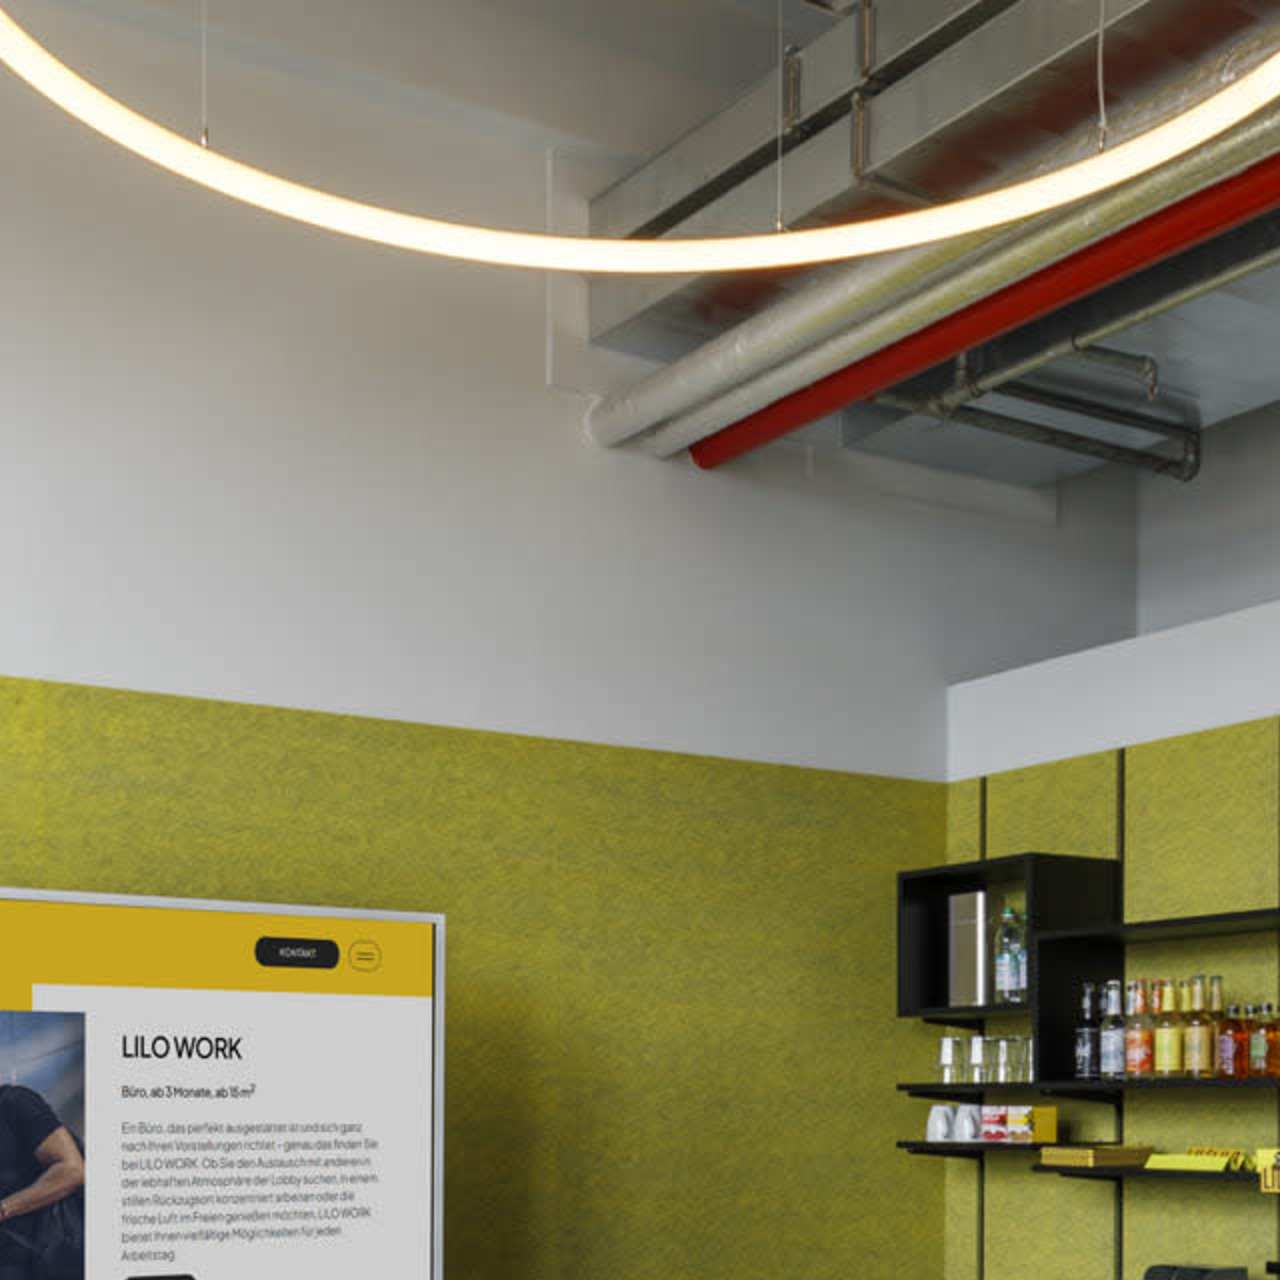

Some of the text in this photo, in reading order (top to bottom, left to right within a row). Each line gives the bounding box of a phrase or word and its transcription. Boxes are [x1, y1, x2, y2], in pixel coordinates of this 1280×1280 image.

[121, 1035, 243, 1060] LILO WORK
[120, 1084, 148, 1099] Büro,
[150, 1085, 164, 1098] ab
[165, 1085, 173, 1098] 3
[215, 1086, 228, 1098] ab
